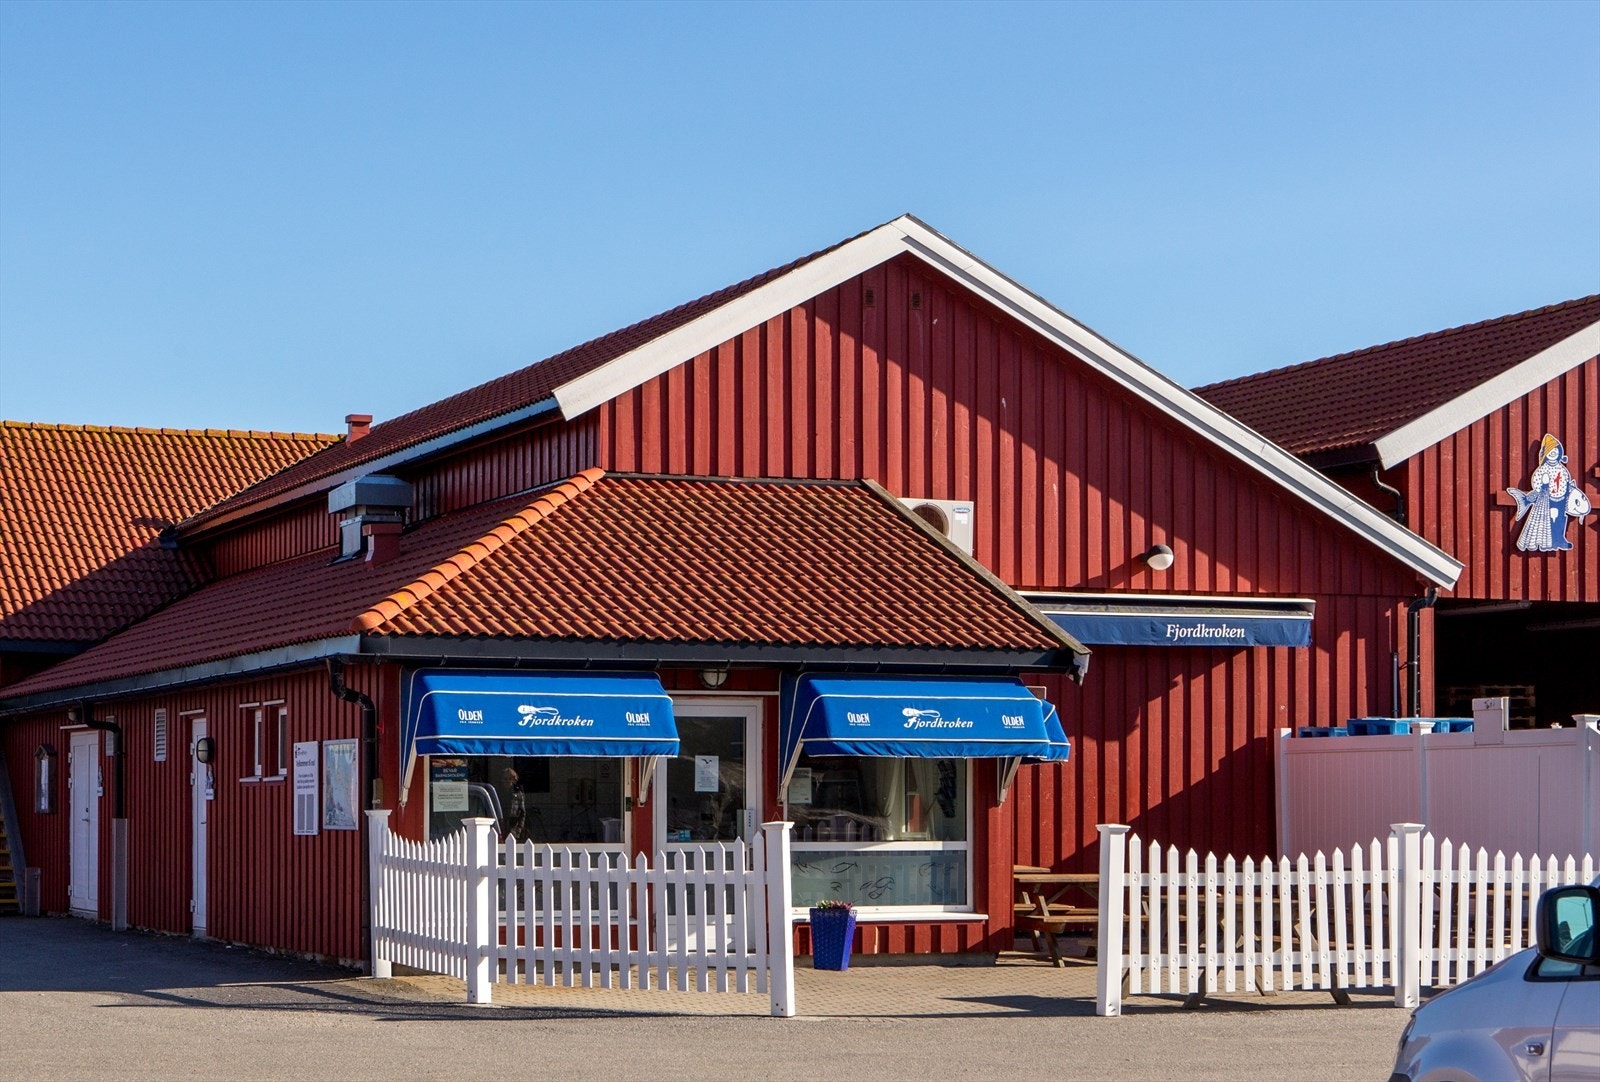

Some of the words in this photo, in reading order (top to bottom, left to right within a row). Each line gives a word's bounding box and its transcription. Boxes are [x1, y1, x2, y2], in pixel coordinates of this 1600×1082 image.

[1166, 623, 1246, 642] Fjordkroken
[458, 708, 483, 721] OLDEN
[518, 714, 594, 728] Fjordkroken
[626, 711, 650, 723] OLDEN
[847, 711, 870, 723] OLDEN
[1002, 714, 1025, 726] OLDEN
[903, 716, 974, 730] Fjordkroken
